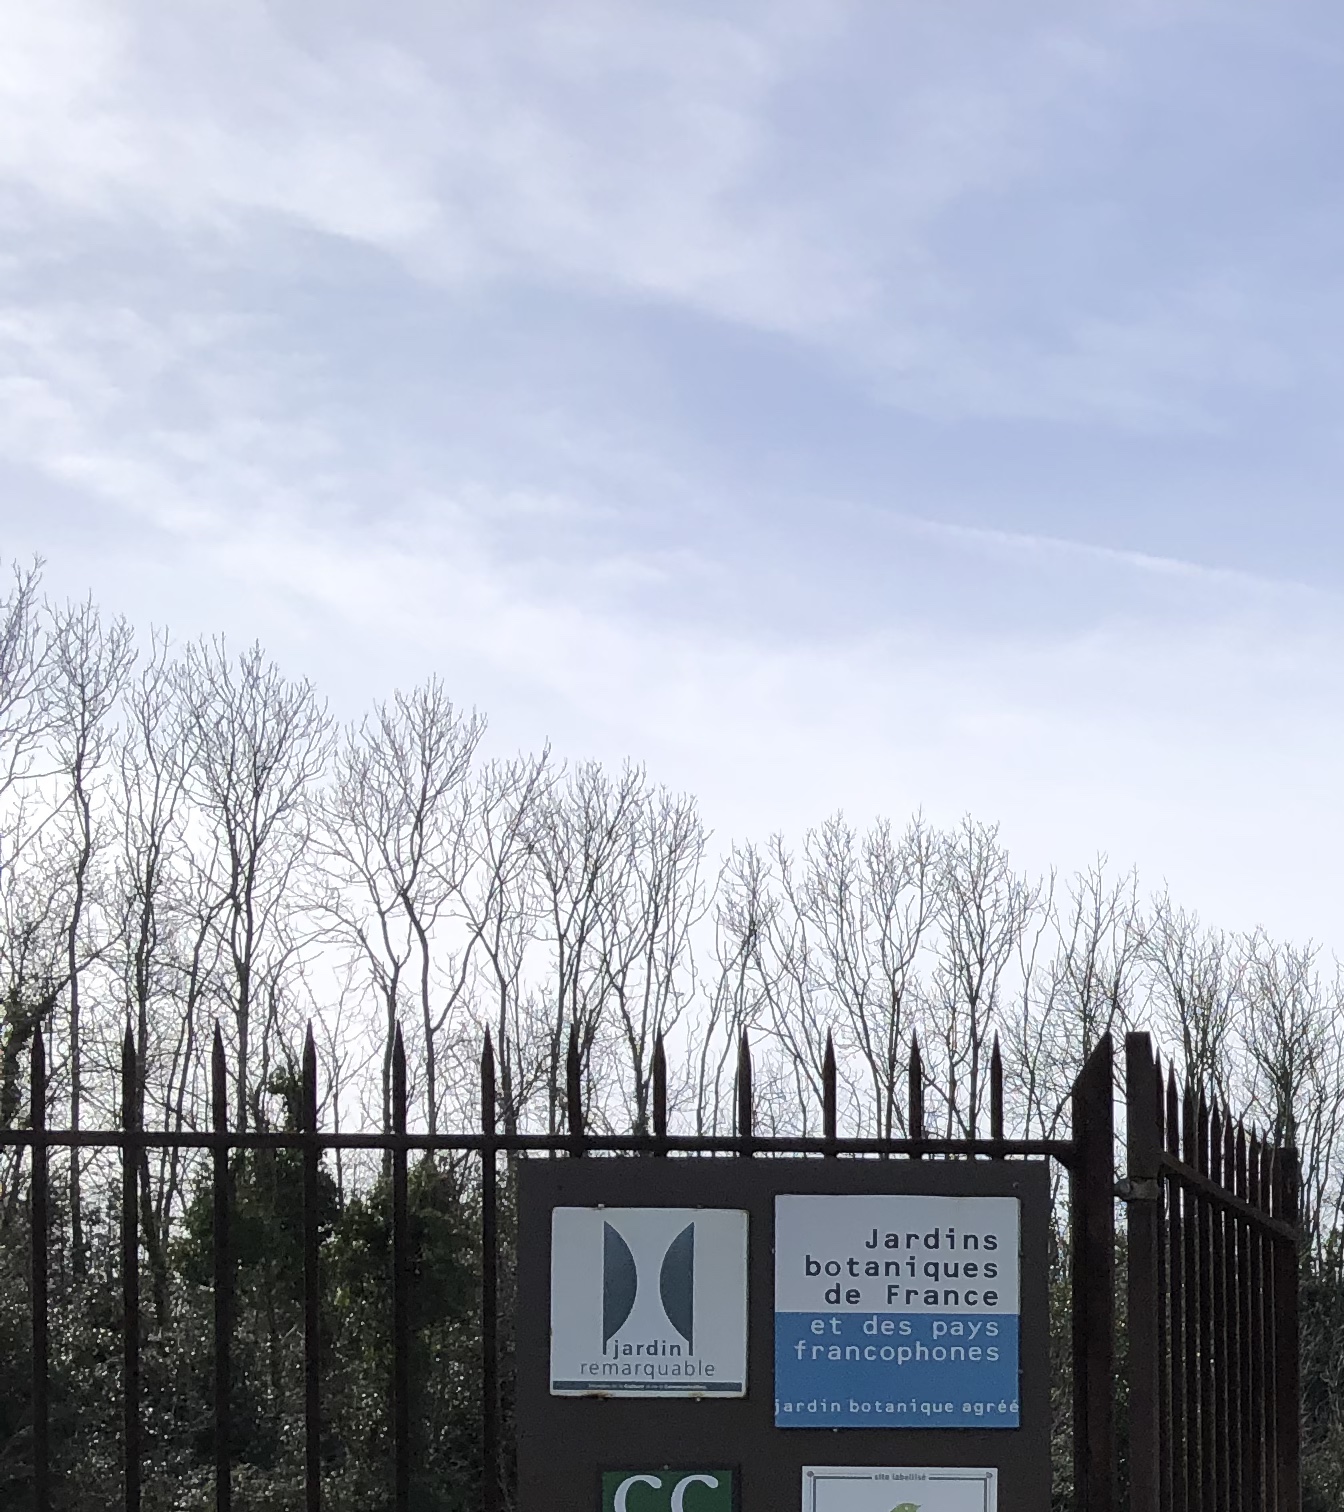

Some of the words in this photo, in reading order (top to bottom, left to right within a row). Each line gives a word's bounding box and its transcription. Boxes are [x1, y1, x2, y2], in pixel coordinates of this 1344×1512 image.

[865, 1227, 998, 1251] Jardins
[805, 1254, 998, 1282] botaniques
[824, 1282, 861, 1305] de
[886, 1284, 999, 1306] France
[810, 1316, 842, 1336] et
[862, 1315, 912, 1336] des
[932, 1320, 999, 1340] pays
[612, 1339, 682, 1360] jardin
[794, 1340, 1000, 1365] francophones
[580, 1360, 715, 1380] remarquable
[774, 1399, 841, 1416] jardin
[849, 1399, 954, 1416] botanique
[962, 1399, 1019, 1416] agréé
